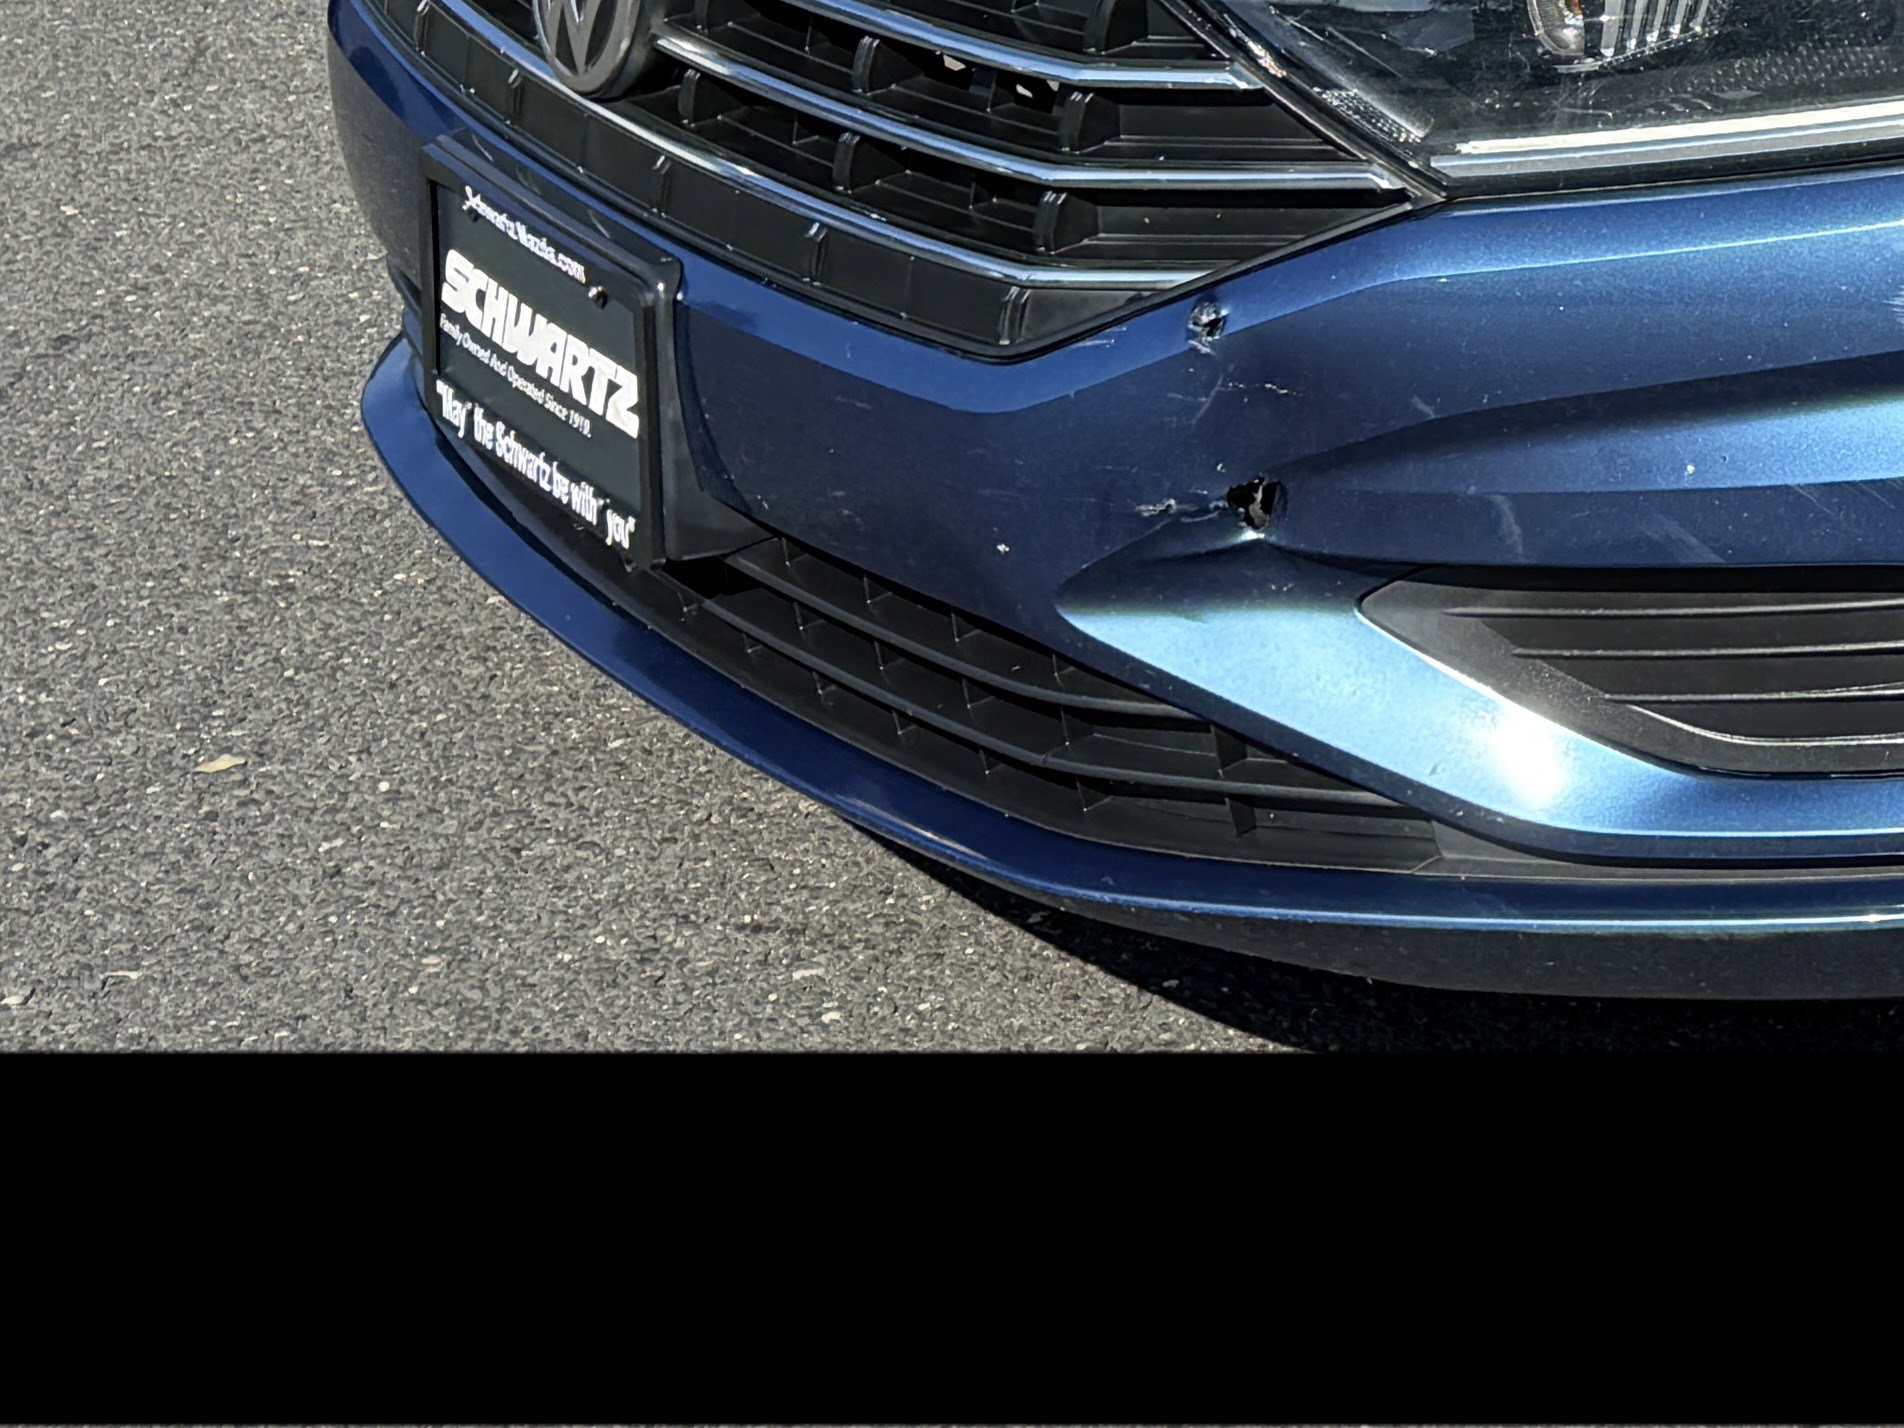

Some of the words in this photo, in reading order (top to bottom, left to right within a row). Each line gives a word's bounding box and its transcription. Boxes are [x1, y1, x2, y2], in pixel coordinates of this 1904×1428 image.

[441, 249, 639, 439] SCHWARTZ
[474, 402, 494, 450] the
[496, 421, 551, 492] Schwartz
[553, 461, 569, 505] be
[570, 481, 597, 526] with
